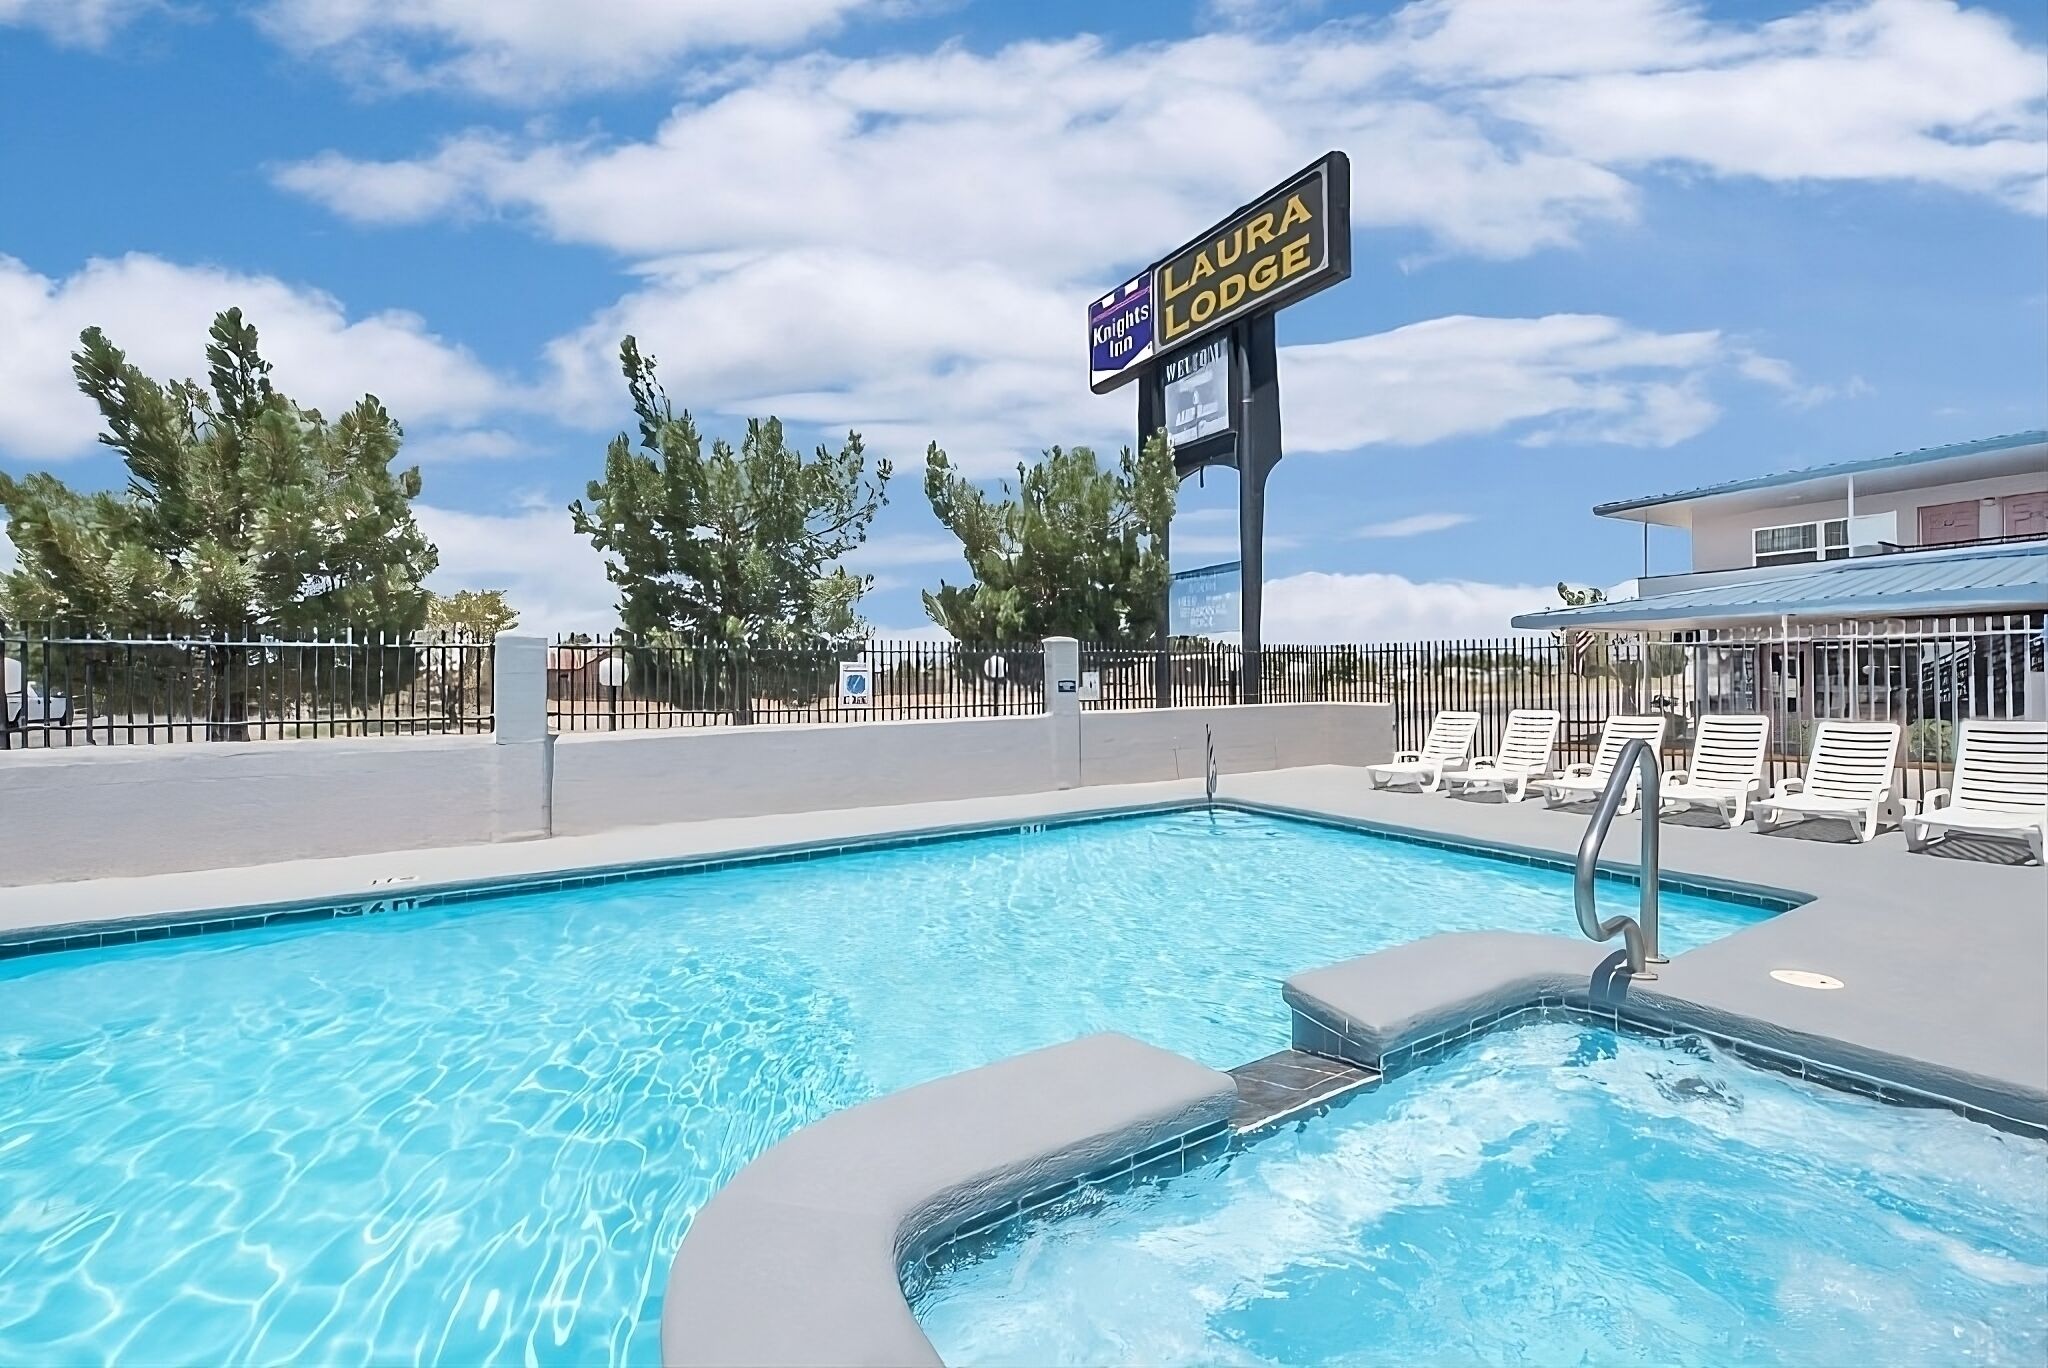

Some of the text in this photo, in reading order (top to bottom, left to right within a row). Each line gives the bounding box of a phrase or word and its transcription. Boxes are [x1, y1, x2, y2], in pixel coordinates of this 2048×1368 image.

[1165, 194, 1313, 301] LAURA
[1165, 233, 1311, 340] LODGE
[1093, 304, 1149, 347] Knights
[1109, 335, 1133, 358] Inn
